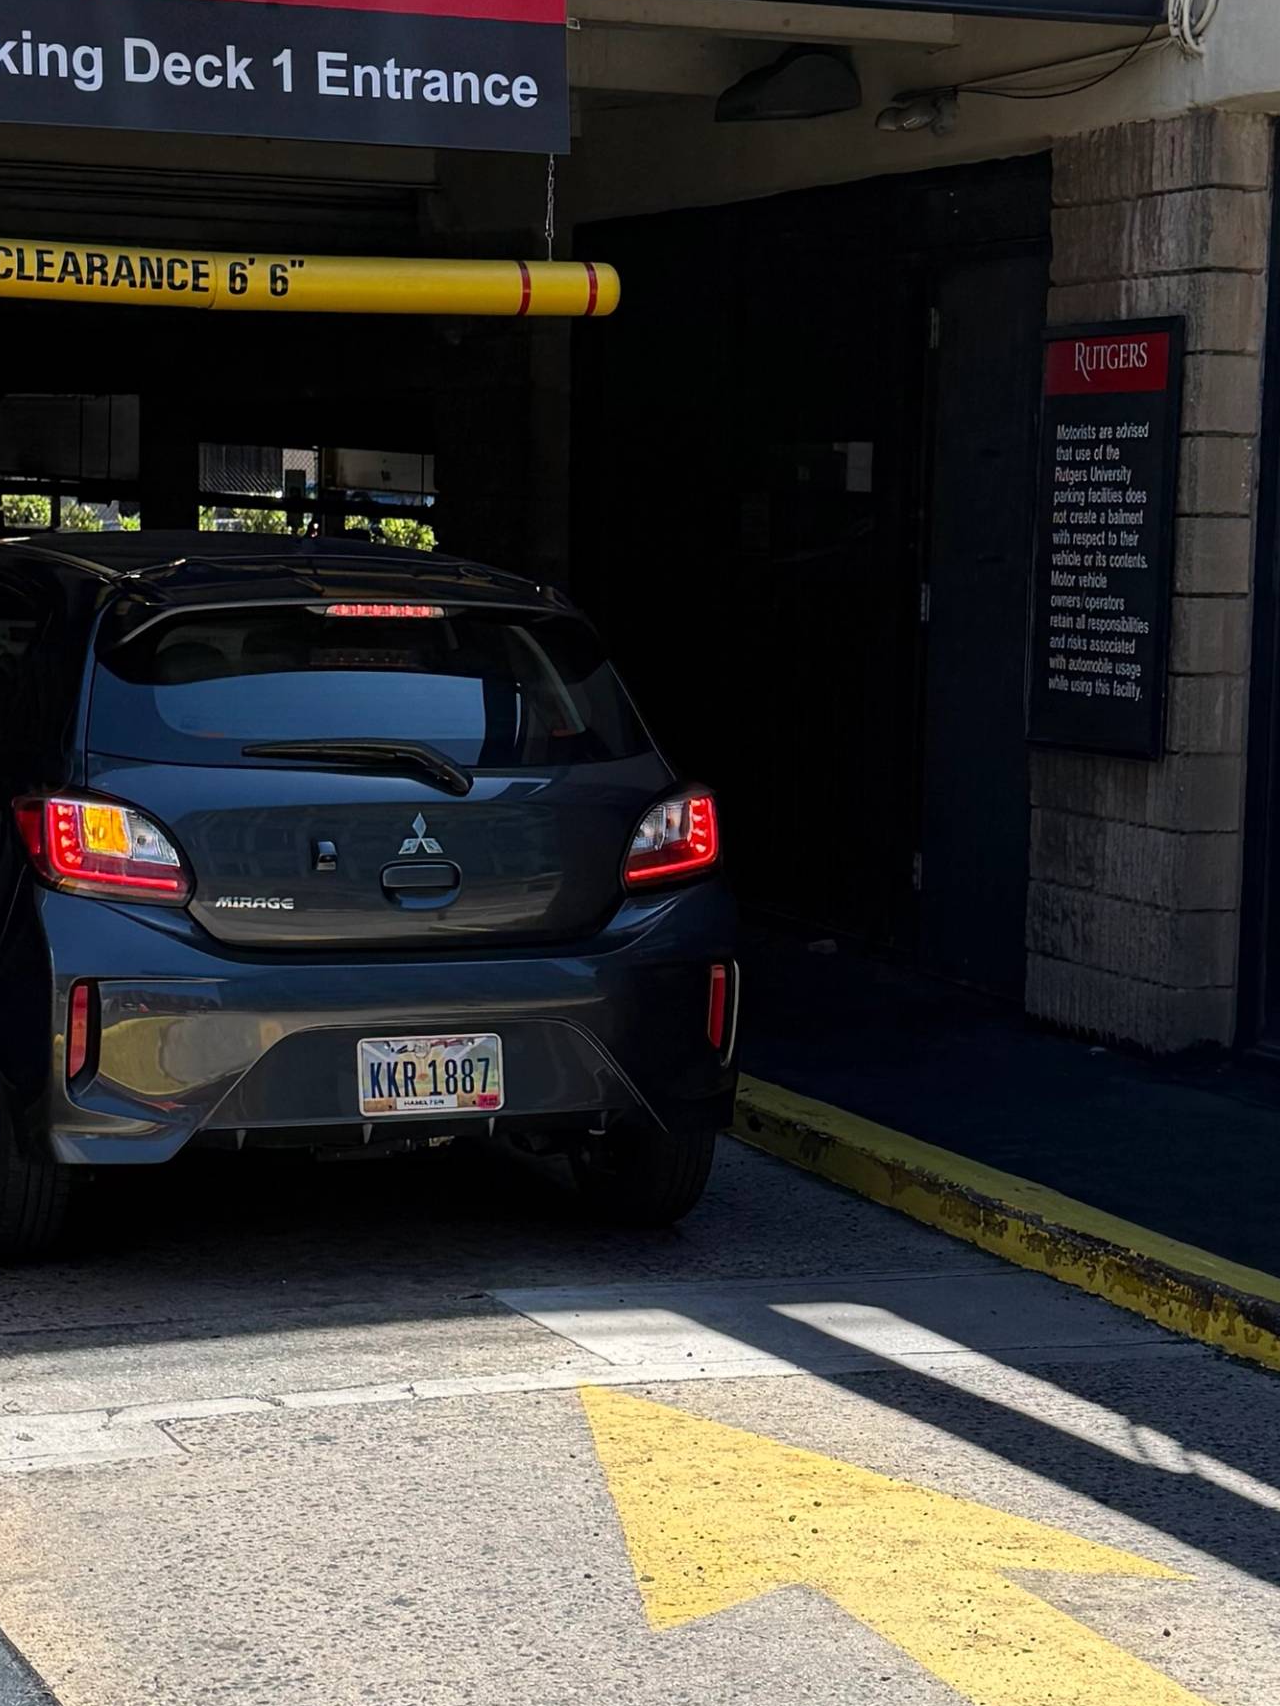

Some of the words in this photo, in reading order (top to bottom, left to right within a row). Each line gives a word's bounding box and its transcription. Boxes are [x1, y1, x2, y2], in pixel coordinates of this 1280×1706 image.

[124, 37, 255, 91] Deck
[272, 48, 293, 93] 1
[317, 50, 538, 108] Entrance
[228, 257, 255, 295] 6'
[1075, 342, 1148, 382] RUTGERS
[1057, 424, 1096, 440] Motorists
[1099, 426, 1113, 439] are
[1116, 421, 1149, 438] advised
[1056, 445, 1072, 461] that
[1075, 448, 1091, 461] use
[1094, 445, 1103, 460] of
[1106, 445, 1120, 460] the
[1055, 466, 1087, 485] Rutgers
[1090, 465, 1131, 485] University
[1053, 487, 1085, 506] parking
[1088, 487, 1123, 503] facilities
[1125, 487, 1147, 503] does
[1052, 509, 1067, 524] not
[1070, 509, 1096, 524] create
[1108, 508, 1143, 525] bailment
[1052, 529, 1070, 544] with
[1073, 531, 1105, 548] respect
[1108, 531, 1117, 546] to
[1120, 530, 1139, 546] their
[1052, 549, 1081, 566] vehicle
[1084, 554, 1094, 566] or
[1095, 551, 1107, 567] its
[1109, 552, 1148, 568] contents.
[1051, 570, 1076, 587] Motor
[1079, 572, 1107, 588] vehicle
[1050, 613, 1073, 629] retain
[1075, 614, 1086, 629] all
[1088, 616, 1149, 634] responsibilities
[1049, 633, 1065, 649] and
[1067, 634, 1087, 651] risks
[1089, 636, 1136, 654] associated
[1049, 654, 1066, 670] with
[1068, 656, 1113, 674] automobile
[1115, 663, 1141, 679] usage
[1048, 674, 1069, 691] while
[1071, 676, 1092, 697] using
[1095, 678, 1110, 695] this
[215, 896, 294, 909] MIRAGE
[370, 1061, 417, 1098] KKR
[428, 1058, 490, 1096] 1887
